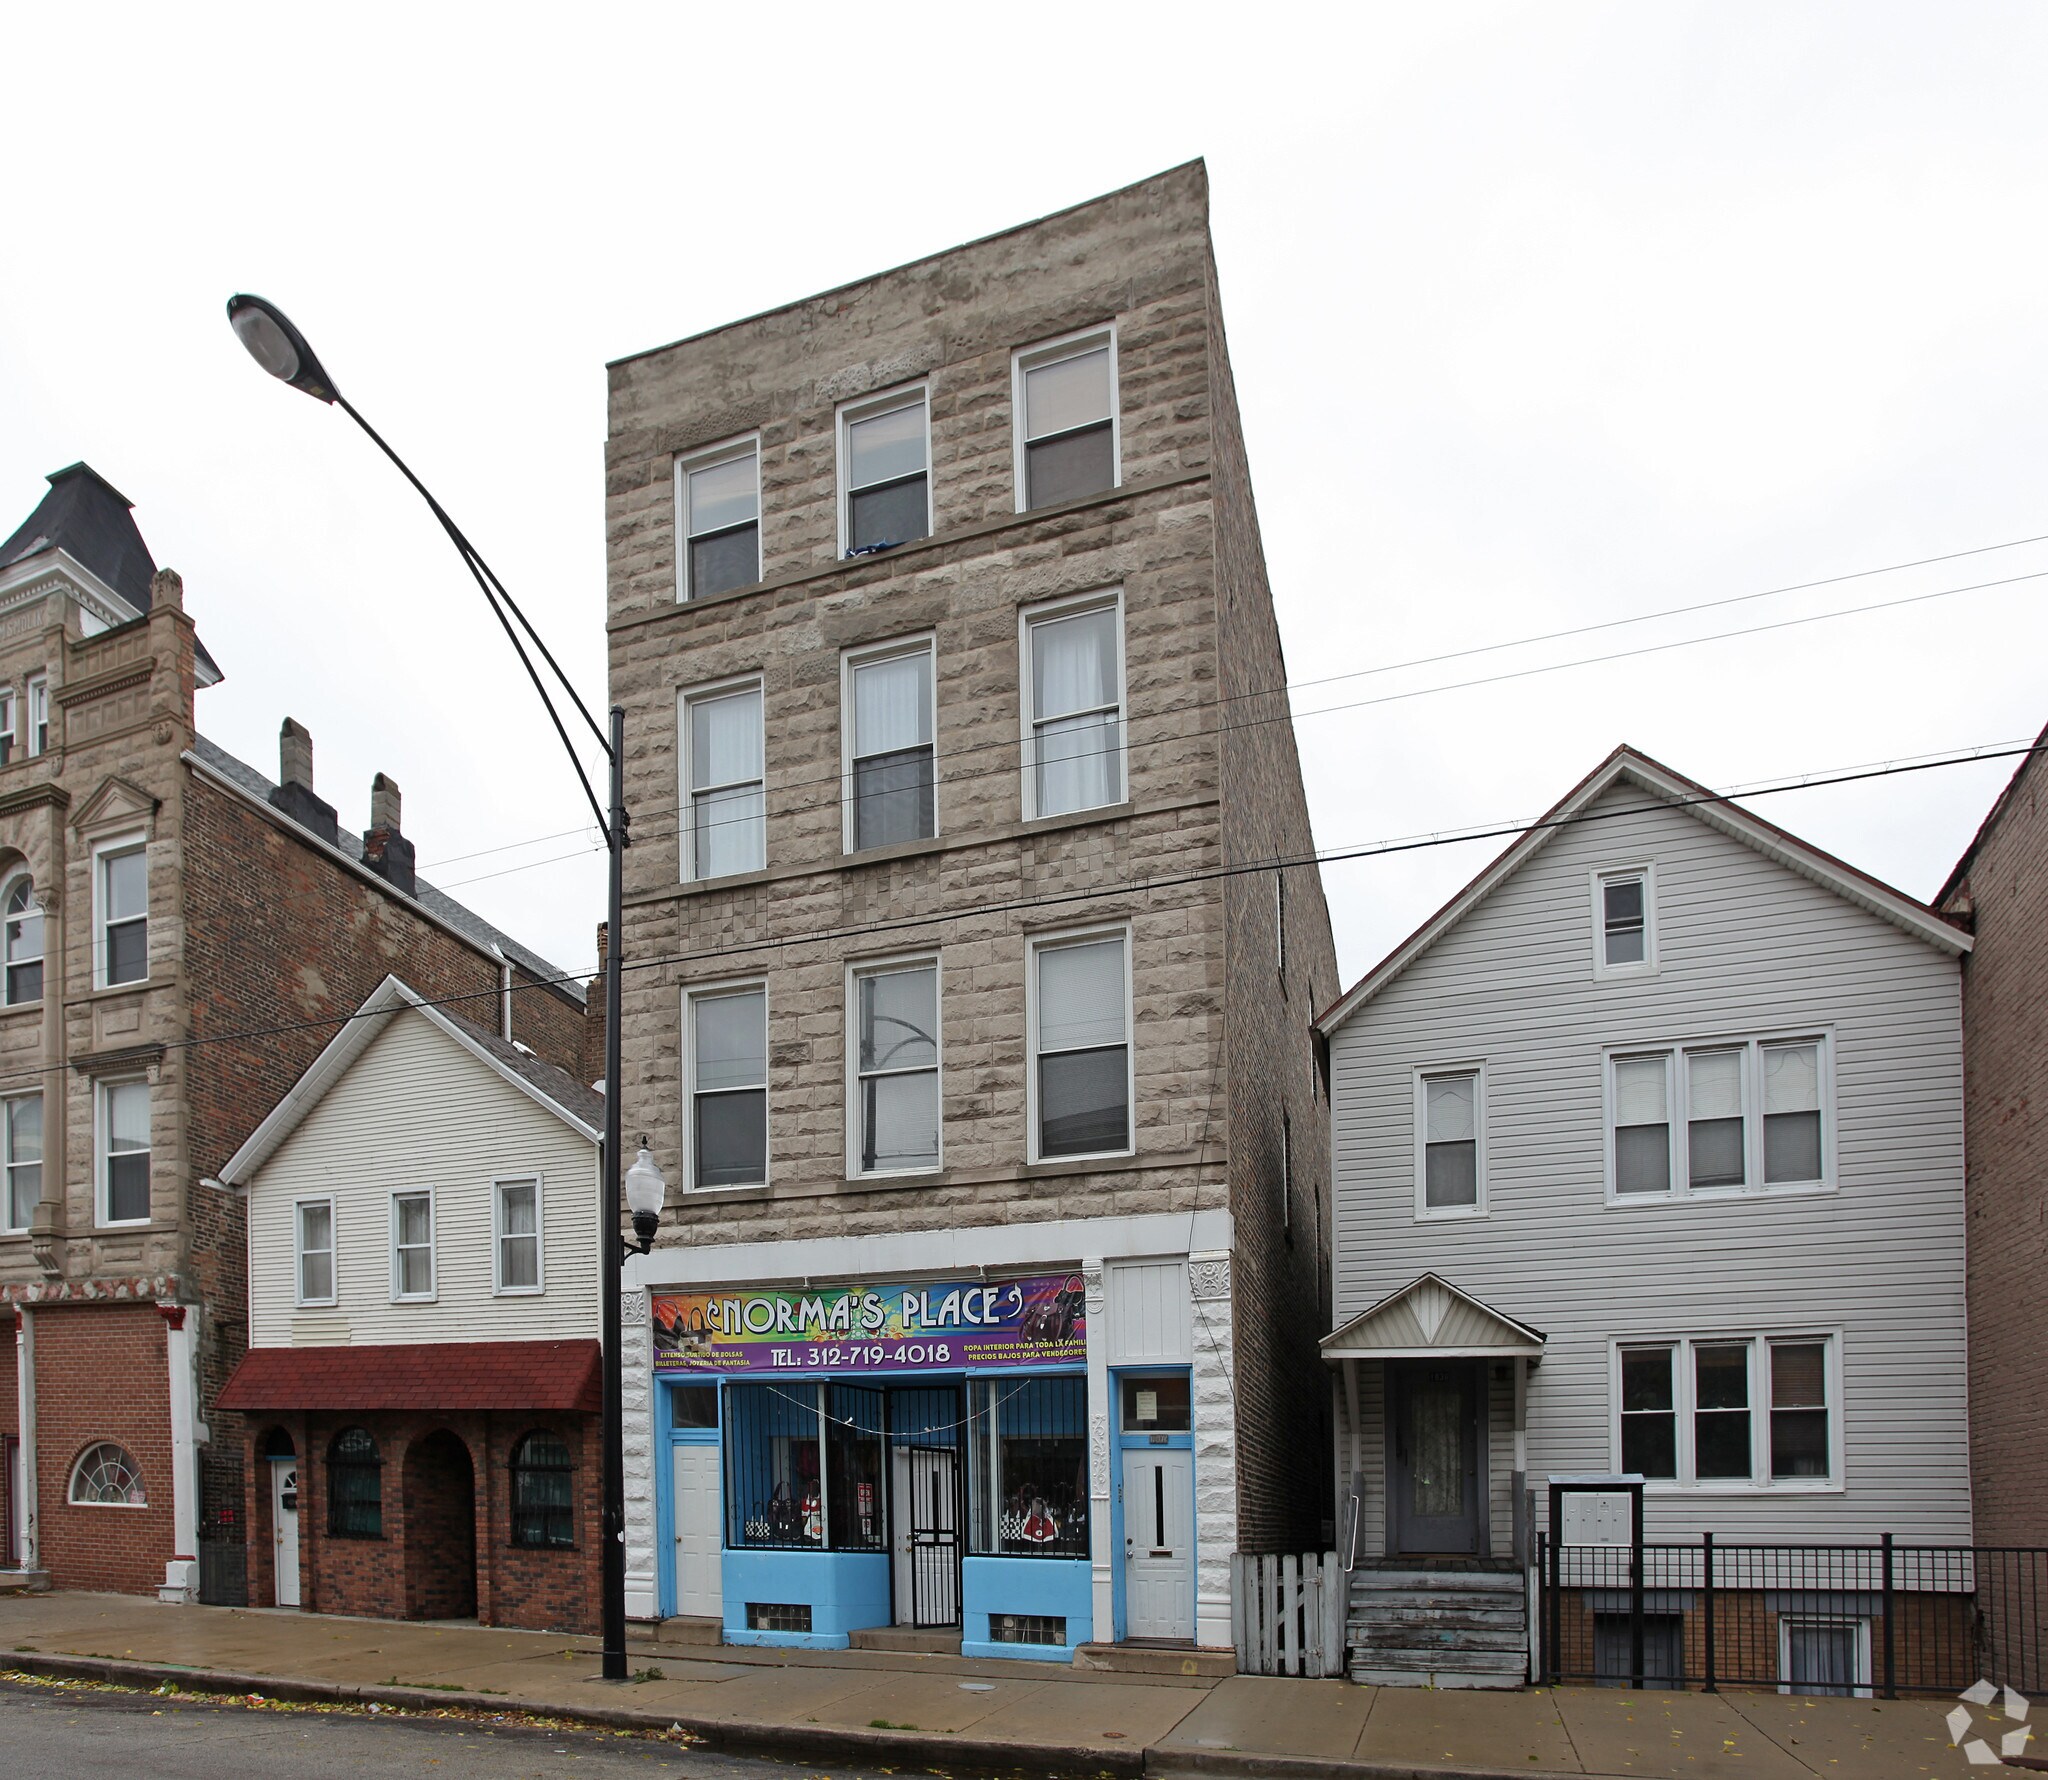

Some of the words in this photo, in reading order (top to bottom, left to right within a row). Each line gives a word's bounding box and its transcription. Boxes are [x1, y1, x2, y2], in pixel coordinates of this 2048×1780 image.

[723, 1293, 886, 1335] NORMA'S
[902, 1287, 1000, 1329] PLACE
[771, 1349, 801, 1366] TEL:
[807, 1344, 951, 1366] 312-719-4018
[964, 1344, 982, 1352] ROPA
[983, 1343, 1014, 1351] INTERIOR
[1016, 1342, 1034, 1350] PARA
[1034, 1341, 1054, 1349] TODA
[968, 1353, 997, 1361] PRECIOS
[998, 1352, 1021, 1360] BAJOS
[1022, 1351, 1040, 1359] PARA
[1041, 1349, 1087, 1358] VENDEDORES
